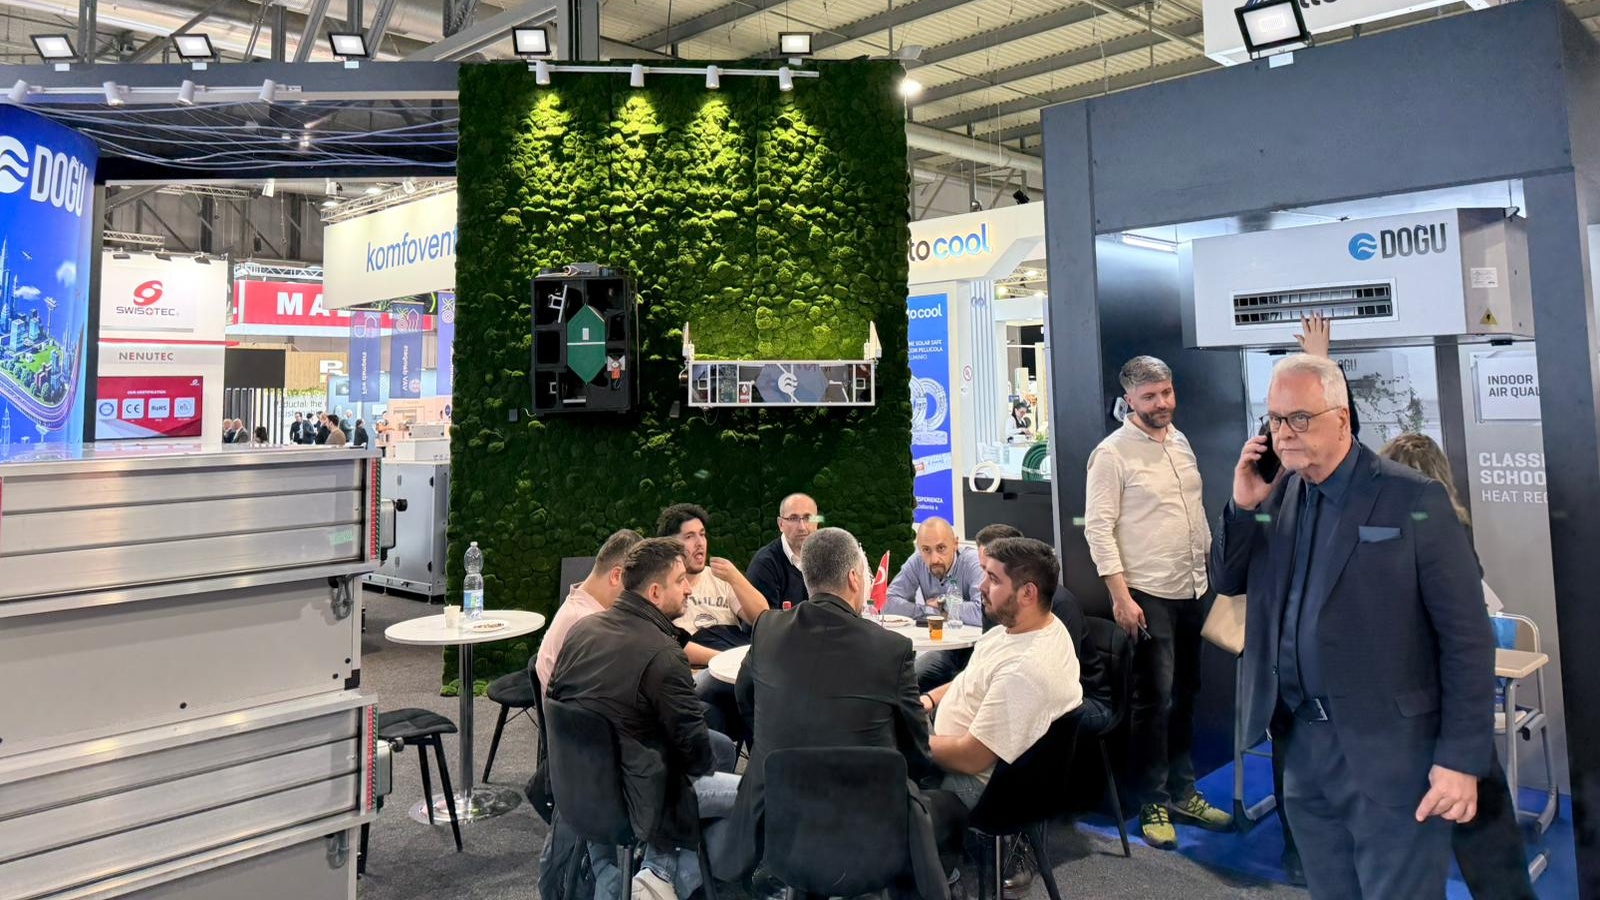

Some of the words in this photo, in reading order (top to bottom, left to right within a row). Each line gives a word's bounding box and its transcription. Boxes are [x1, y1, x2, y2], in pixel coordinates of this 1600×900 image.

[30, 144, 88, 217] DOĞU
[1380, 223, 1447, 259] DOĞU
[276, 291, 350, 317] MA
[116, 306, 176, 316] SWISOTEC
[119, 352, 175, 361] NENUTEC
[1487, 374, 1533, 385] INDOOR
[1489, 387, 1508, 397] AIR
[1482, 490, 1518, 502] HEAT
